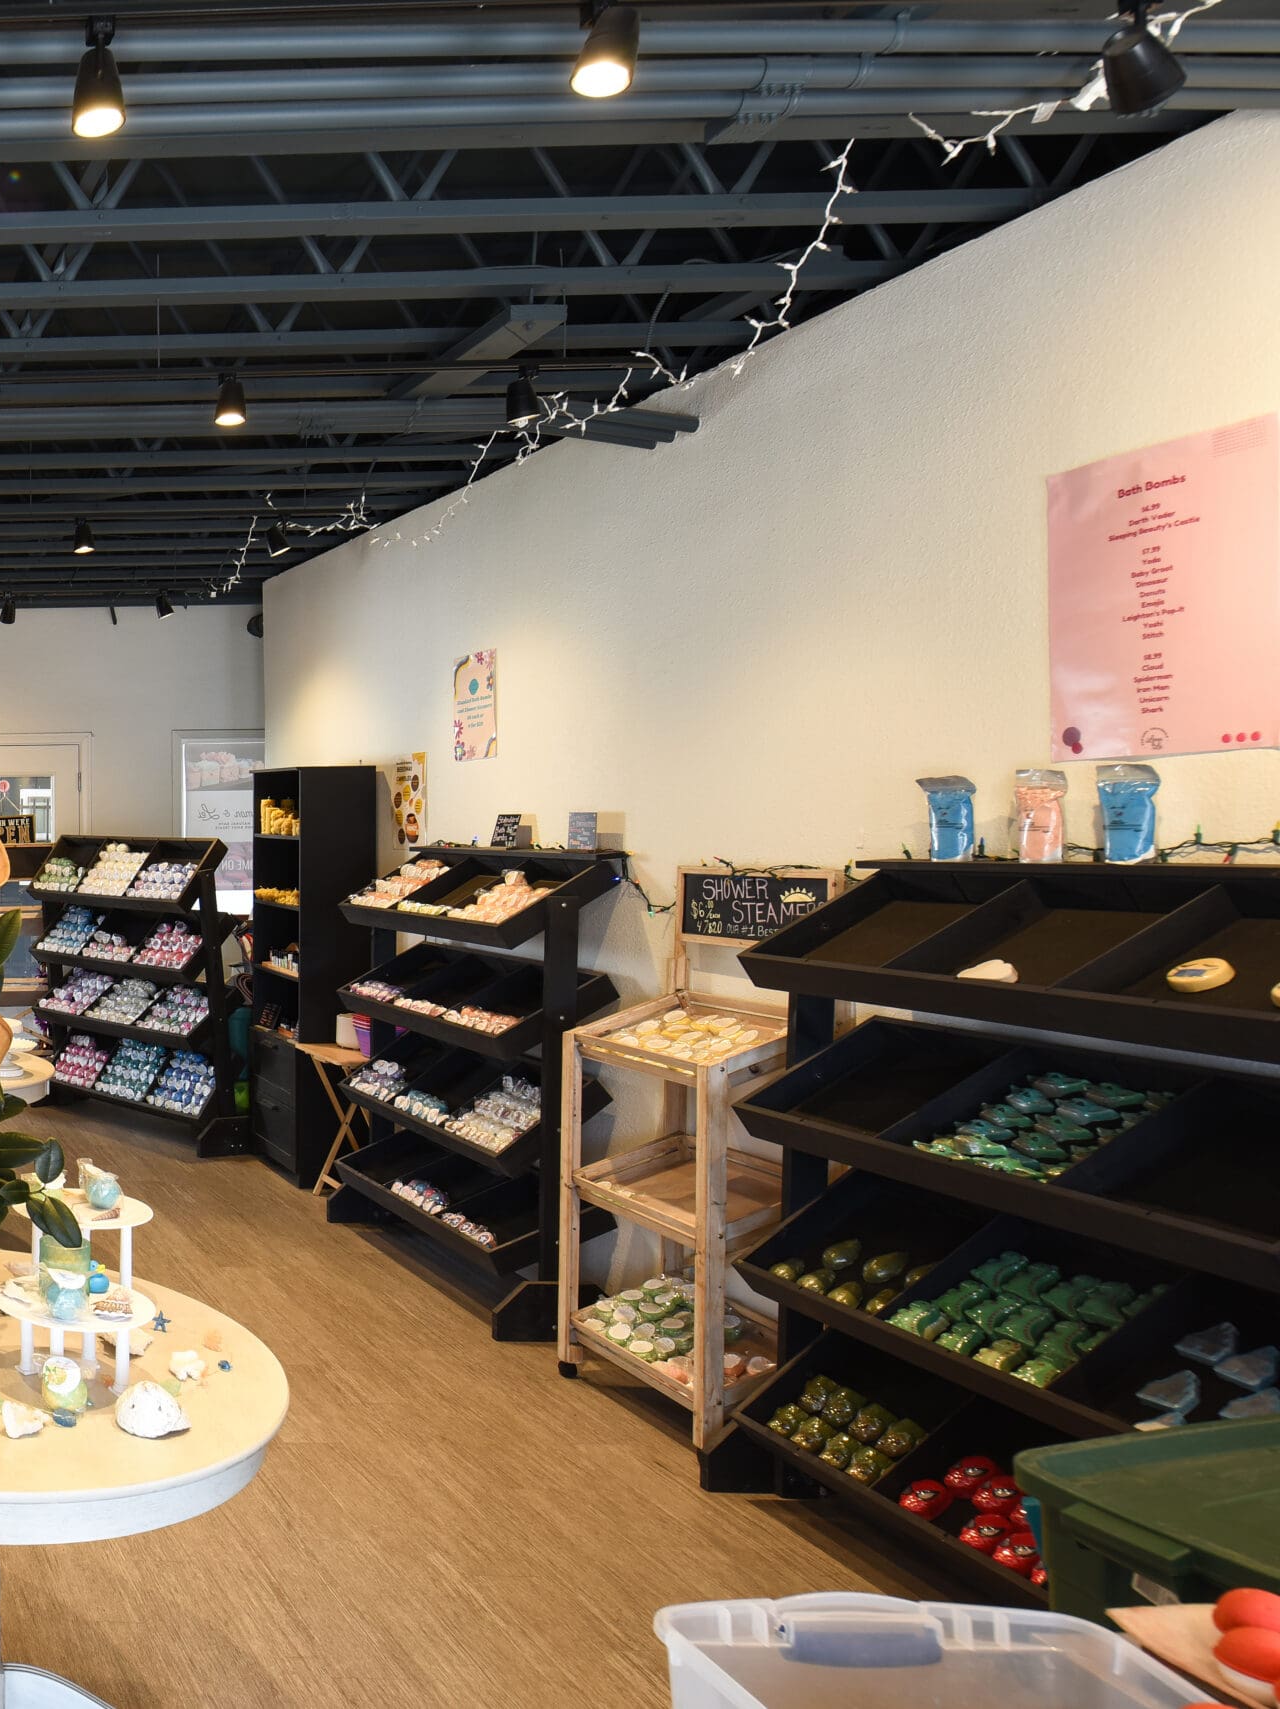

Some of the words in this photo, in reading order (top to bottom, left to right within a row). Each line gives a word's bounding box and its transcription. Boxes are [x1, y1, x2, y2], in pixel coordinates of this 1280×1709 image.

[1118, 485, 1142, 498] Bath
[1145, 475, 1186, 491] Bombs
[1129, 518, 1148, 526] Darth
[1151, 512, 1175, 520] Vader
[1109, 532, 1137, 541] Sleeping
[1139, 523, 1171, 534] Beauty's
[1174, 517, 1200, 527] Castle
[1151, 565, 1173, 574] Groot
[1136, 578, 1168, 588] Dinosaur
[1140, 589, 1165, 598] Donuts
[1142, 632, 1164, 640] Stitch
[1142, 663, 1164, 671] Cloud
[1134, 674, 1173, 683] Spiderman
[703, 878, 769, 901] SHOWER
[732, 900, 825, 924] STEAMER
[727, 923, 739, 932] OUR
[741, 925, 755, 936] #1
